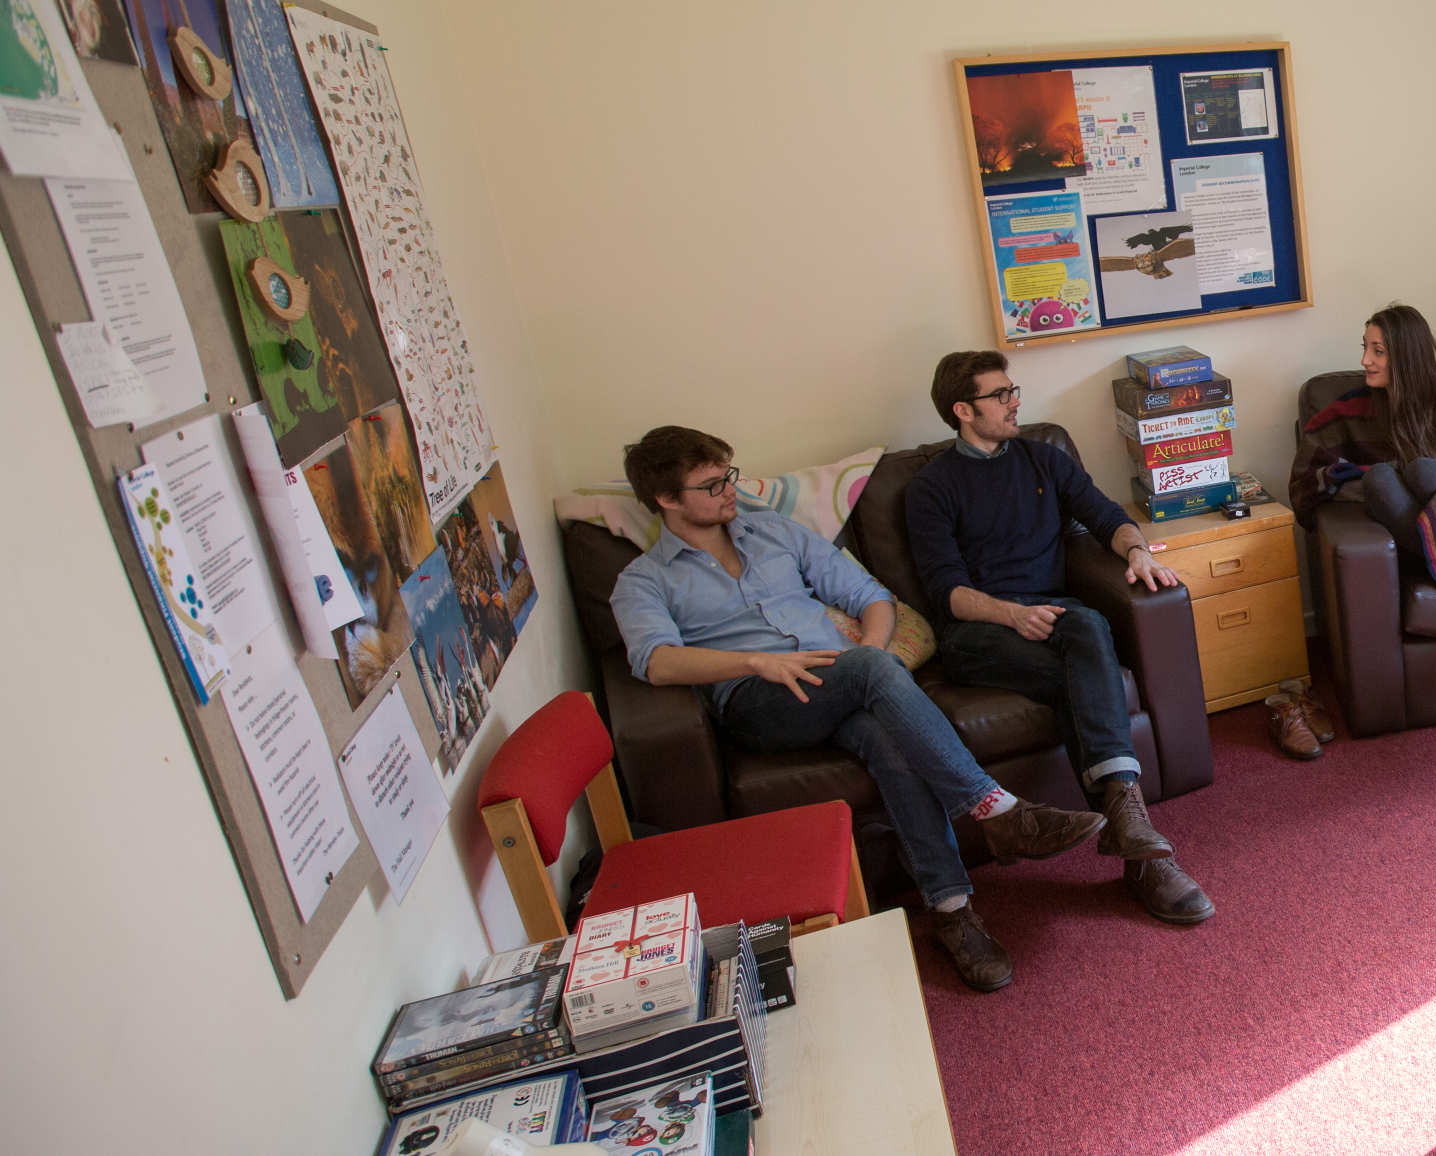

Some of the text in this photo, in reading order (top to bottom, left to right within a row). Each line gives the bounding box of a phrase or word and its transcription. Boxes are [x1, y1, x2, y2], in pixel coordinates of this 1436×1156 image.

[1142, 421, 1169, 433] TICKET
[1177, 416, 1195, 427] RIDE
[1152, 433, 1225, 459] Articulate!
